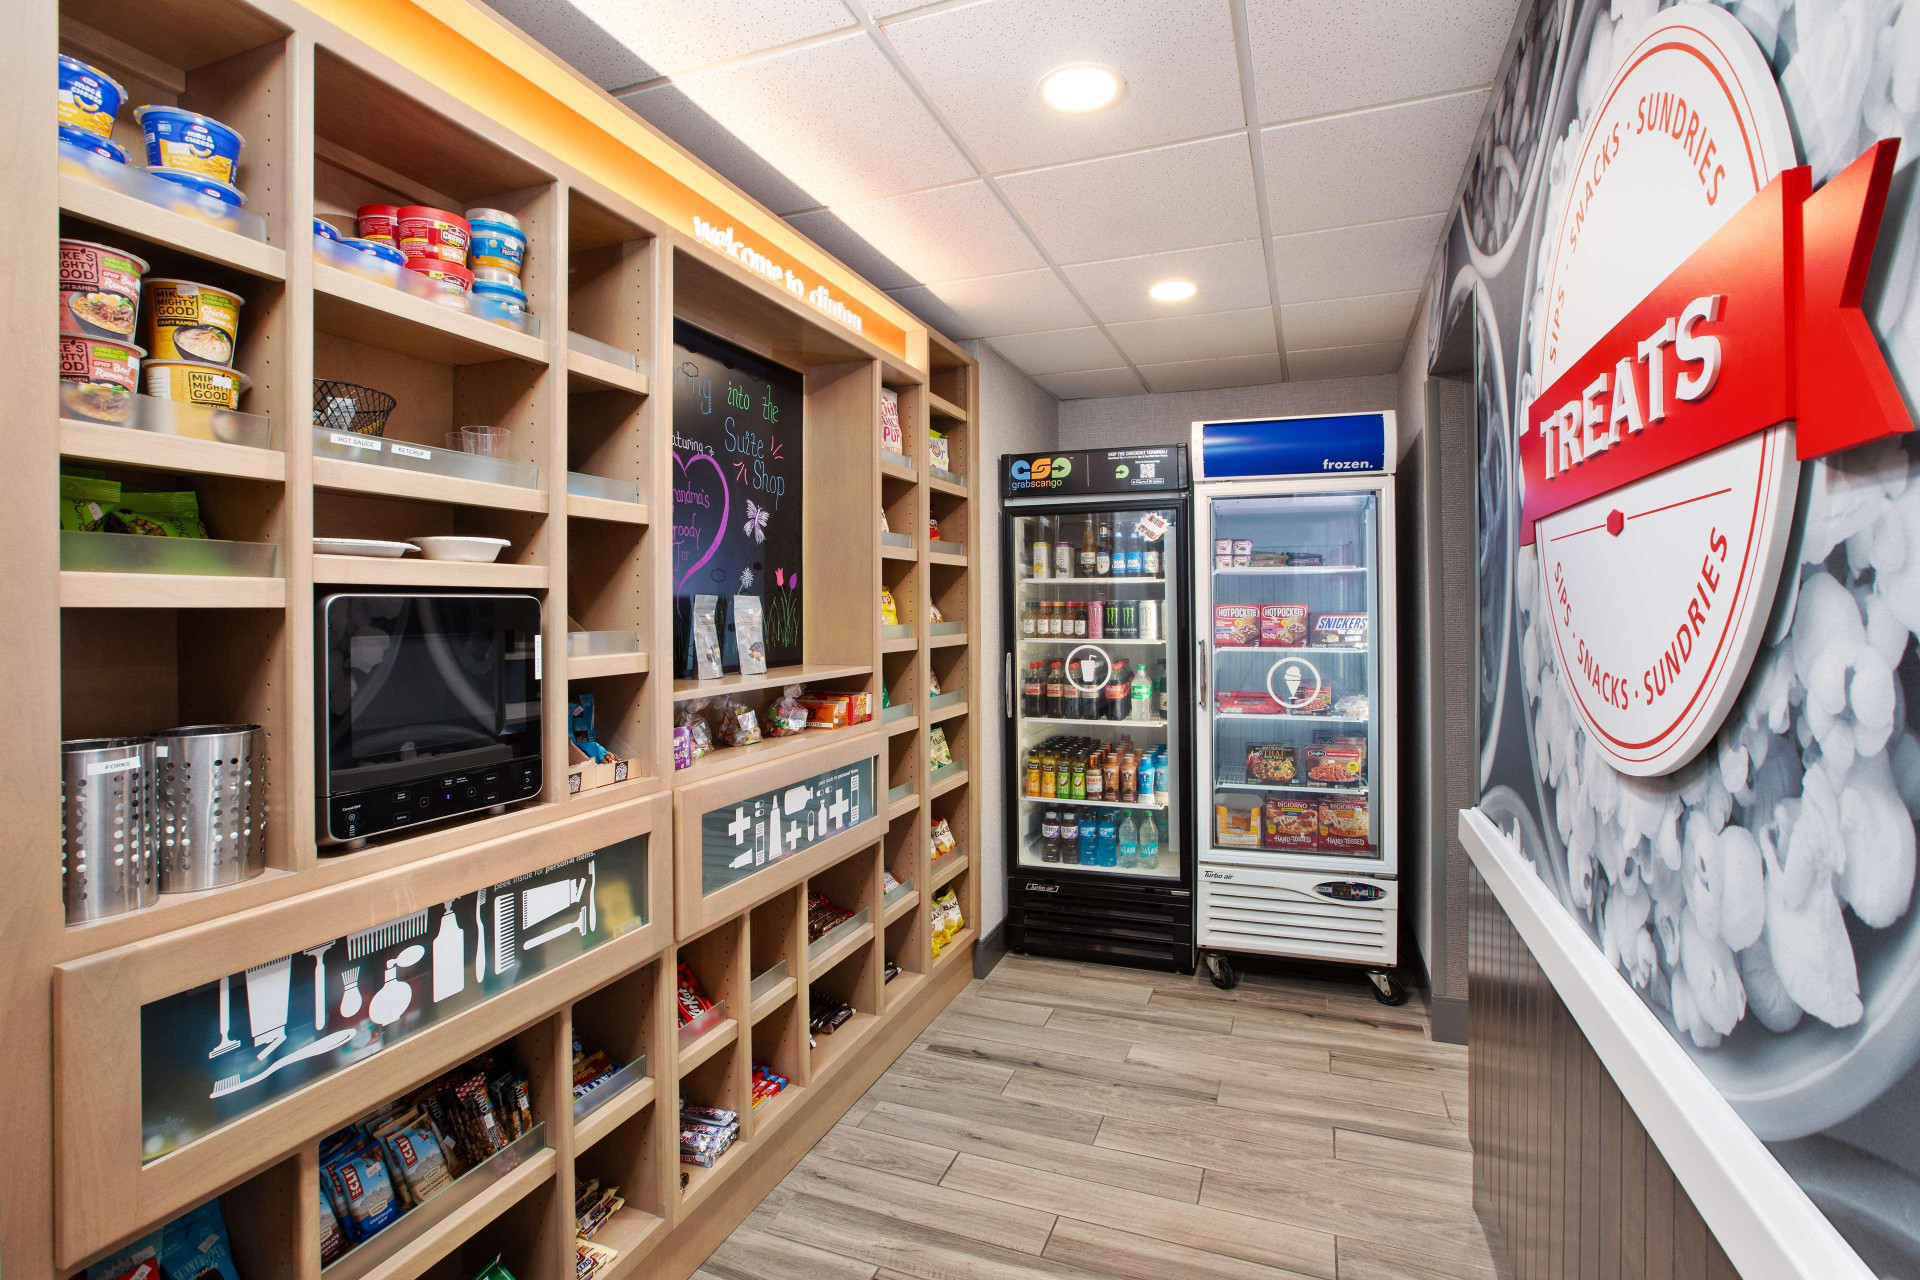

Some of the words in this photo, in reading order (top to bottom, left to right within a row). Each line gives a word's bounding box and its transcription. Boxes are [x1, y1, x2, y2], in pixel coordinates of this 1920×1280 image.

[1548, 285, 1566, 364] SIPS
[1570, 121, 1621, 254] SNACKS
[1636, 91, 1725, 206] SUNDRIES
[60, 250, 94, 262] IKE'S
[693, 216, 783, 281] Welcome
[785, 269, 804, 299] to
[60, 260, 94, 271] IGHTY
[60, 268, 94, 280] OOD
[157, 299, 195, 308] MIGHTY
[158, 306, 194, 317] GOOD
[201, 305, 231, 322] Chicken
[1540, 295, 1727, 480] TREATS
[194, 391, 229, 401] GOOD
[728, 381, 750, 410] into
[763, 385, 779, 423] the
[725, 416, 764, 459] Suite
[884, 426, 900, 443] POP
[338, 436, 352, 444] HOT
[353, 439, 375, 448] SAUCE
[673, 431, 703, 455] aturing
[398, 447, 425, 457] KETCHUP
[1323, 459, 1374, 470] frozen.
[753, 460, 785, 510] Shop
[1011, 479, 1062, 490] grabscango
[673, 481, 710, 508] randma's
[1318, 617, 1368, 629] SNICKERS
[1554, 561, 1572, 627] SIPS
[1577, 638, 1629, 711] SNACKS
[1643, 526, 1728, 706] SUNDRIES
[105, 762, 131, 770] FORKS
[1204, 871, 1222, 879] Turbo
[474, 1089, 489, 1114] KIND
[369, 1208, 393, 1225] CHOCOLATE
